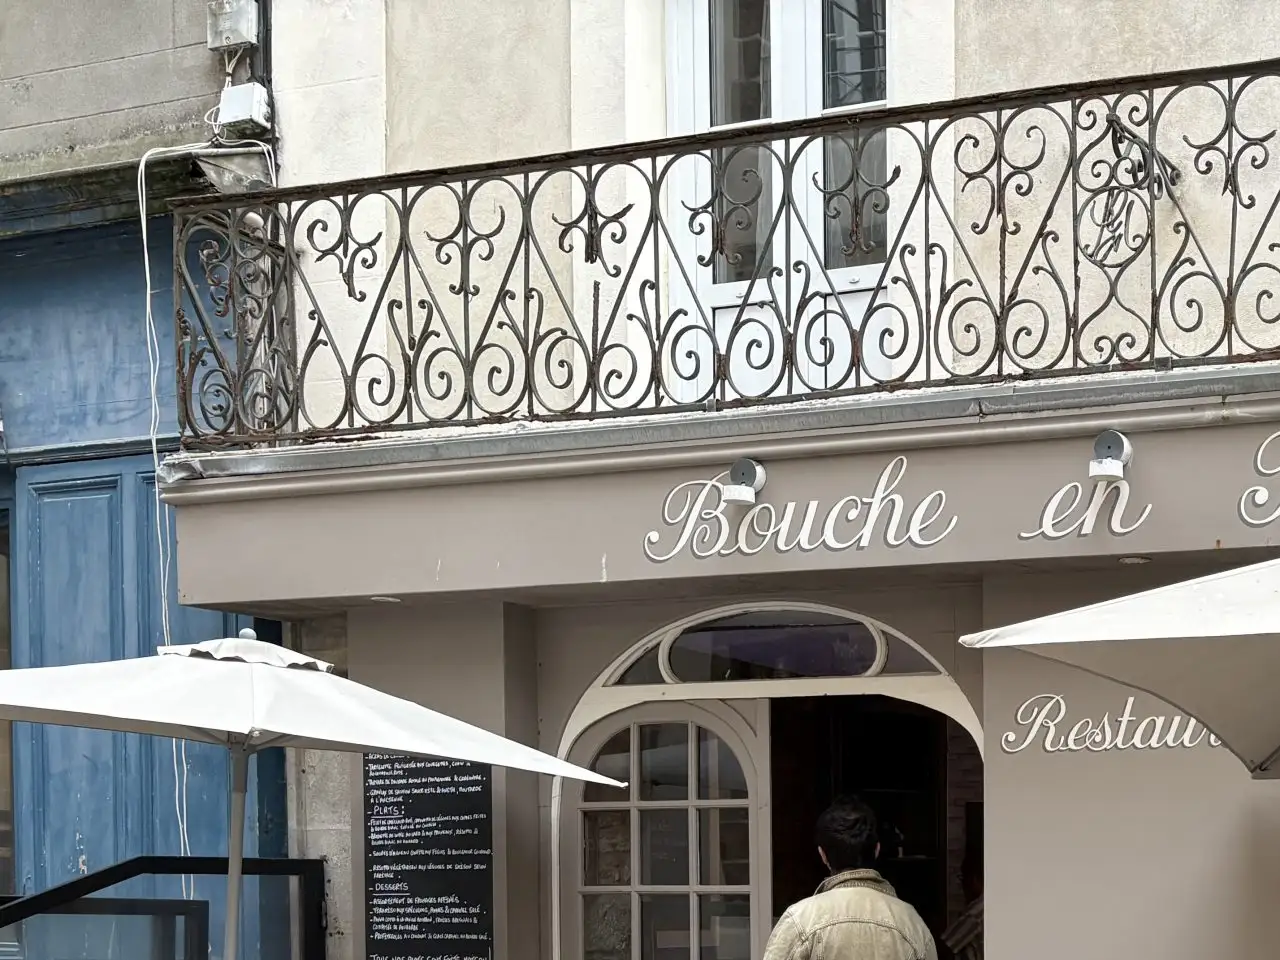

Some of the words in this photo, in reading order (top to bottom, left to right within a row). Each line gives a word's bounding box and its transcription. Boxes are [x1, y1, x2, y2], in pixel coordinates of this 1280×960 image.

[644, 456, 958, 562] Bouche
[1018, 480, 1153, 540] en
[375, 882, 409, 892] DESSERTS
